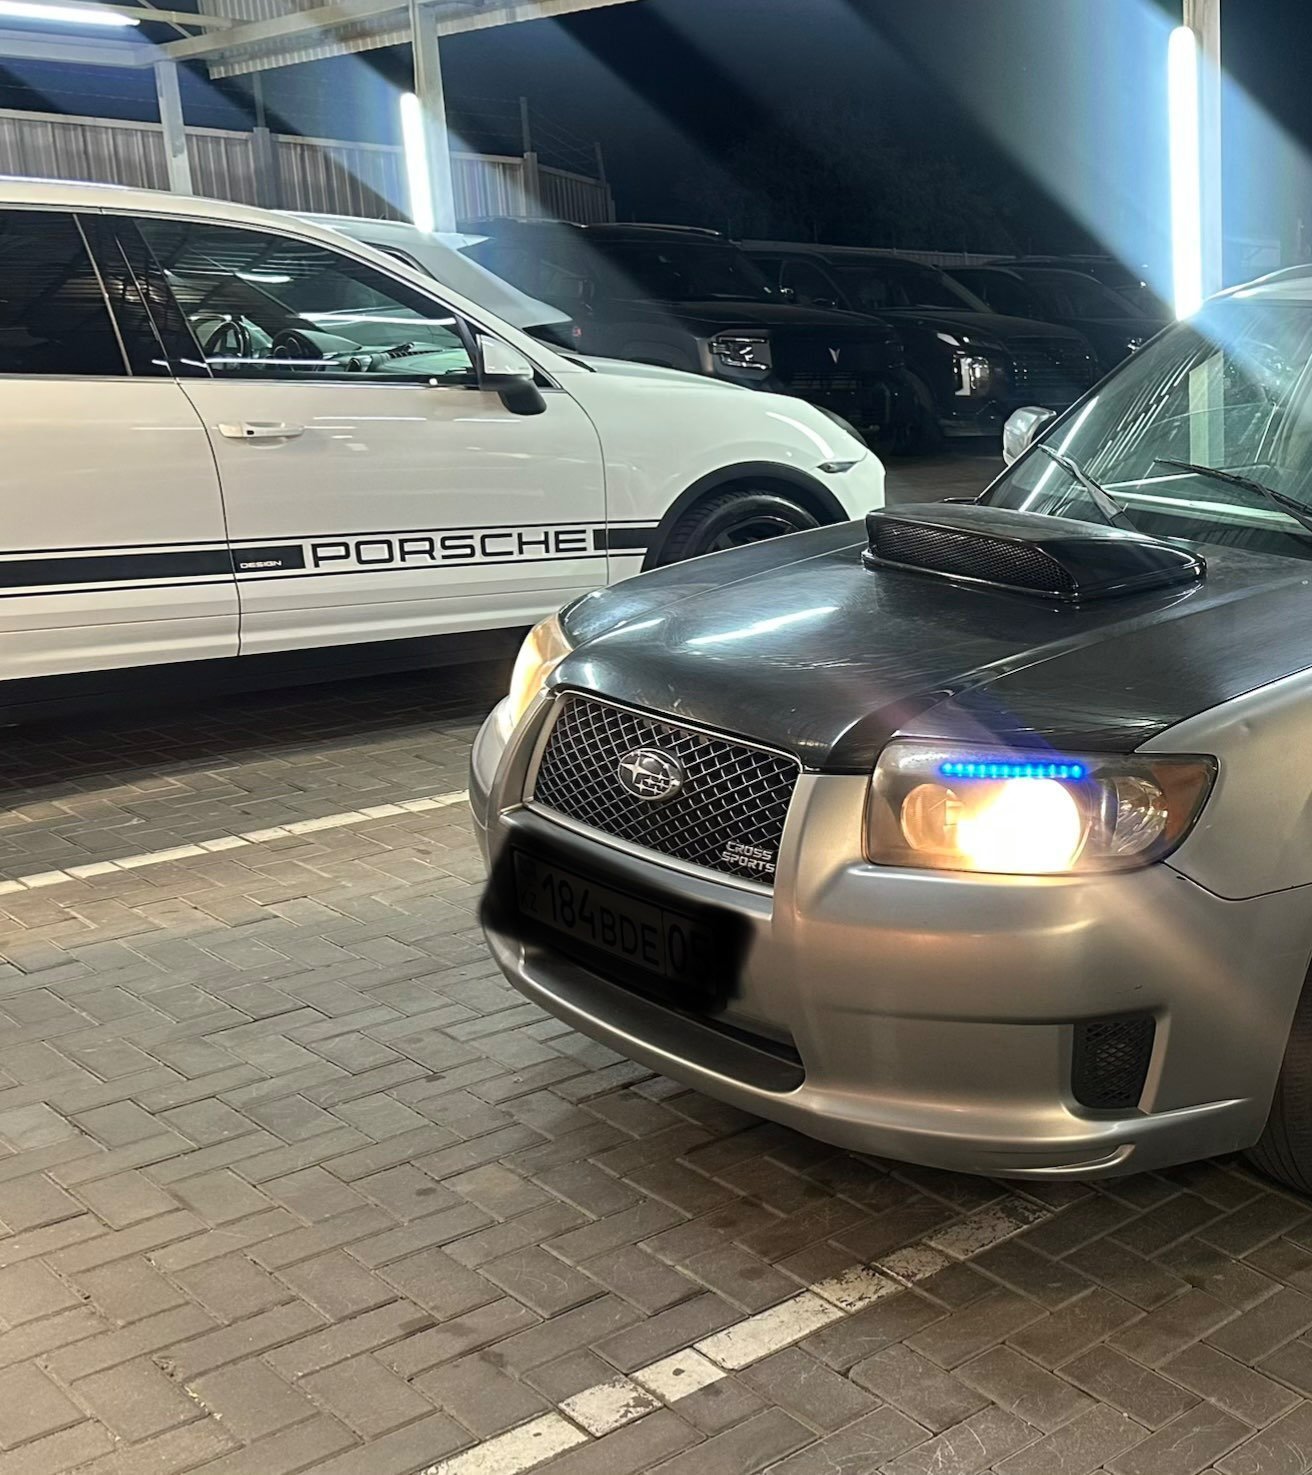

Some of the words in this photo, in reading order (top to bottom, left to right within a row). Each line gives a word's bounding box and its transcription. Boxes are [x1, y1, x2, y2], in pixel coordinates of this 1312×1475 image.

[240, 560, 282, 569] DESIGN
[311, 529, 588, 568] PORSCHE
[721, 851, 776, 873] SPORTS
[726, 841, 773, 861] CROSS
